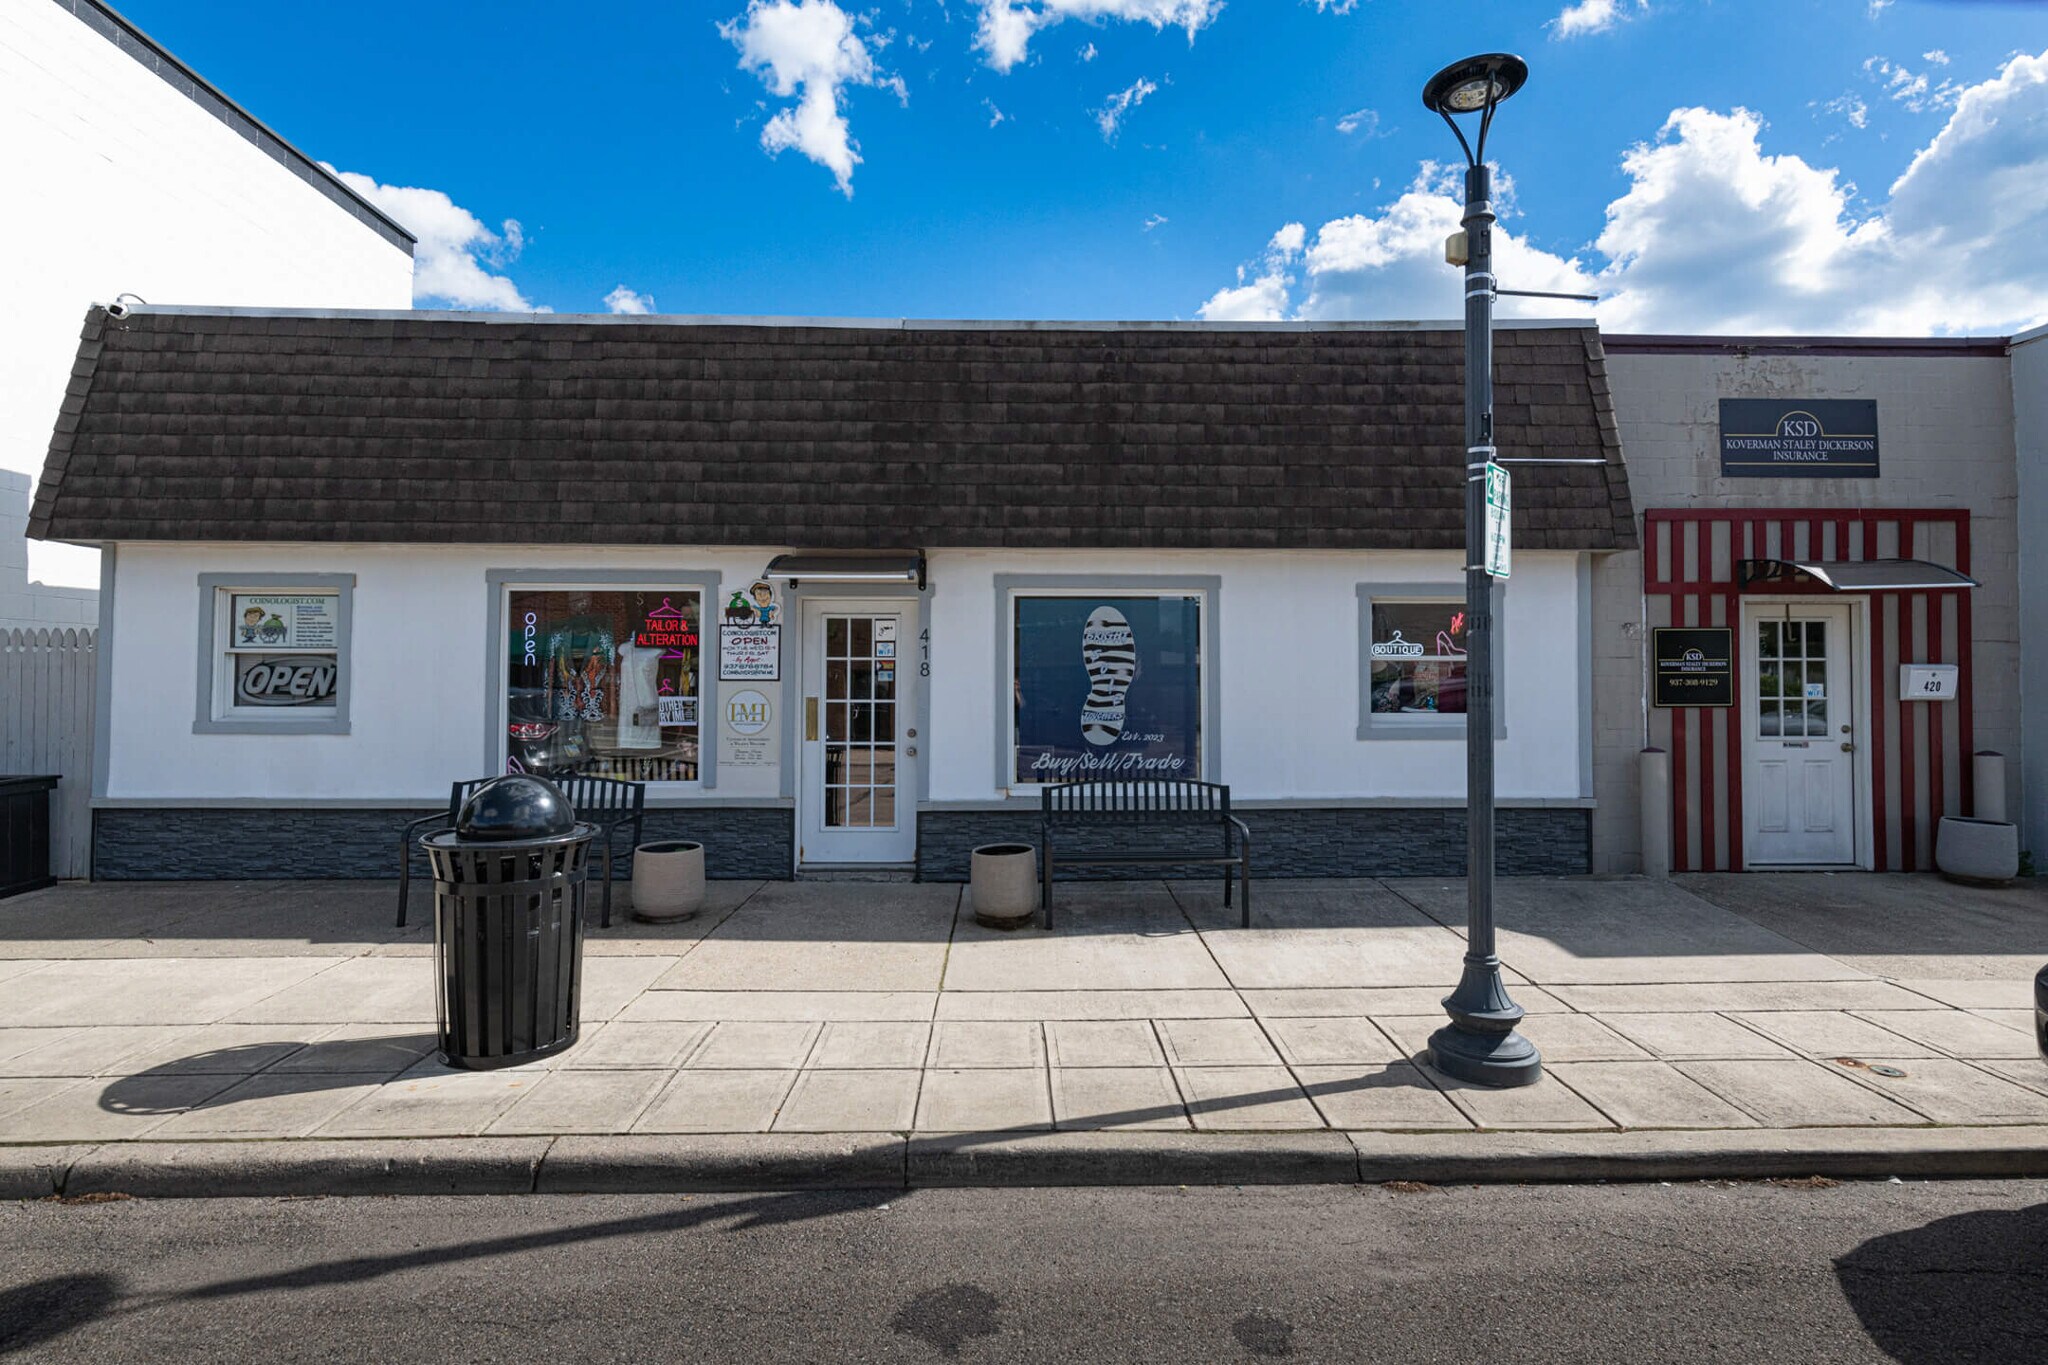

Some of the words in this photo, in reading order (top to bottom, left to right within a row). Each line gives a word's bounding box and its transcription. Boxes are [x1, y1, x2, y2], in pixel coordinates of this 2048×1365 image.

[1783, 420, 1818, 437] KSD
[1726, 439, 1781, 450] KOVERMAN
[1783, 440, 1817, 450] STALEY
[1819, 440, 1874, 451] DICKERSON
[1773, 451, 1828, 461] INSURANCE
[1487, 471, 1493, 499] 2
[645, 619, 678, 631] TAILOR
[680, 619, 689, 631] &
[637, 633, 698, 646] ALTERATION
[731, 636, 768, 646] OPEN
[919, 628, 930, 677] 418
[1374, 645, 1421, 655] BOUTIQUE
[1686, 652, 1703, 661] KSD
[244, 664, 337, 698] OPEN
[1923, 680, 1942, 692] 420
[1143, 733, 1165, 743] 2023
[1031, 752, 1185, 775] Buy/Sell/Trade
